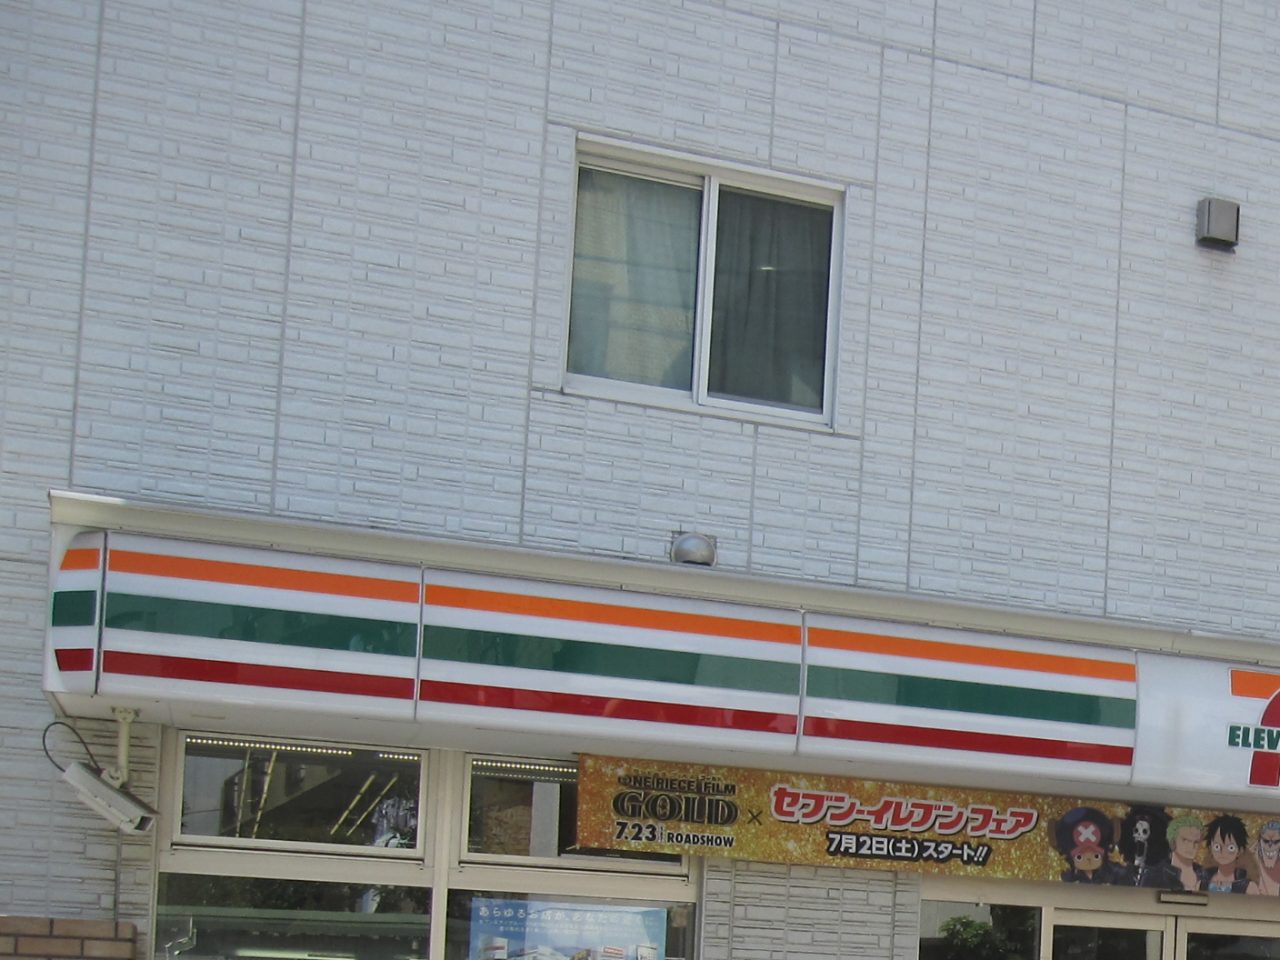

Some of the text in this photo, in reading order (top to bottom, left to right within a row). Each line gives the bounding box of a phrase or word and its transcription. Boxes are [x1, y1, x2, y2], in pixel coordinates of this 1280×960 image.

[701, 781, 737, 796] FILM
[611, 789, 739, 826] GOLD
[615, 820, 735, 848] 7.23 ROADSHOW
